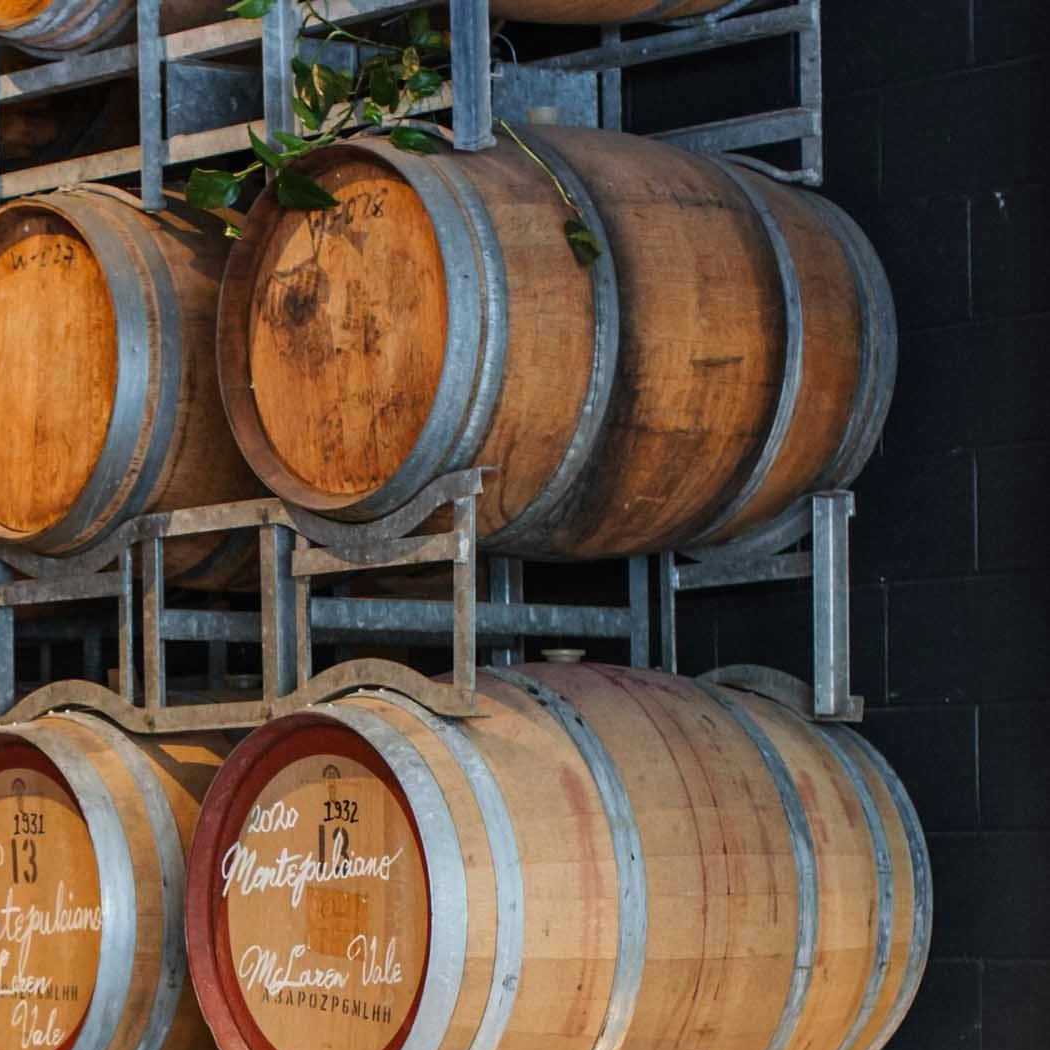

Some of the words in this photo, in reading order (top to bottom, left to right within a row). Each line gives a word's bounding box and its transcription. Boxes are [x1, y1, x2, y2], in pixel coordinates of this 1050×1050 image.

[13, 812, 45, 836] 1931
[248, 800, 299, 833] 2020
[323, 799, 359, 823] 1932
[10, 837, 38, 885] 13
[346, 934, 404, 987] Vale
[11, 999, 66, 1050] Vale
